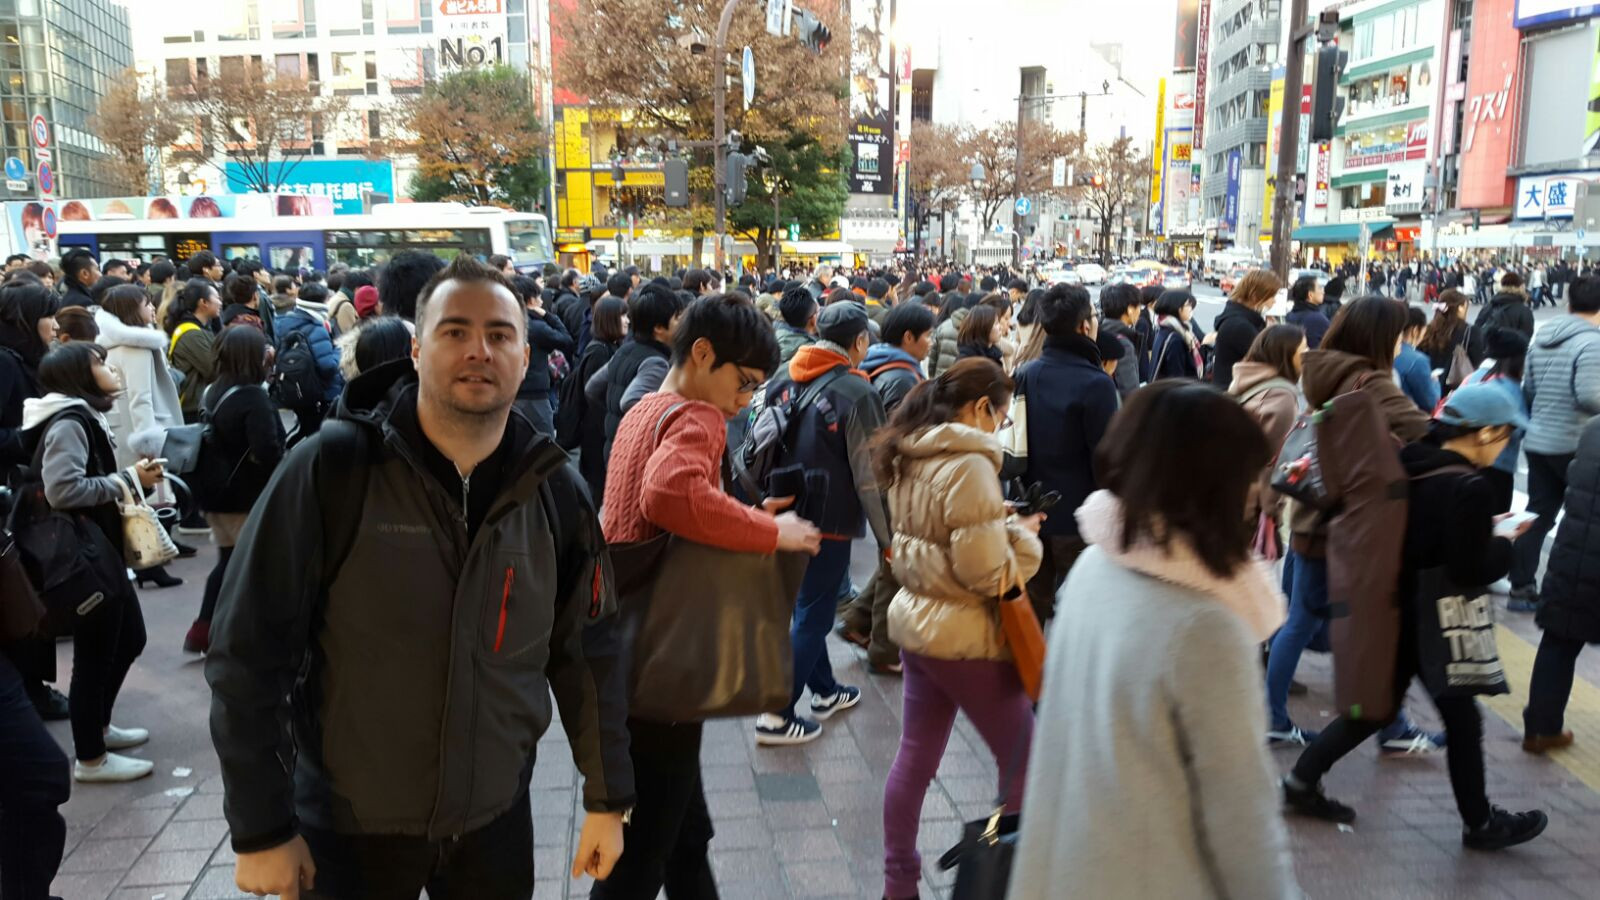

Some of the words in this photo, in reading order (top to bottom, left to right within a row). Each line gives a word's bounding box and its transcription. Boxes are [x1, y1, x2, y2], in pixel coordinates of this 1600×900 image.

[440, 36, 503, 67] No.1
[1464, 71, 1514, 152] クスリ
